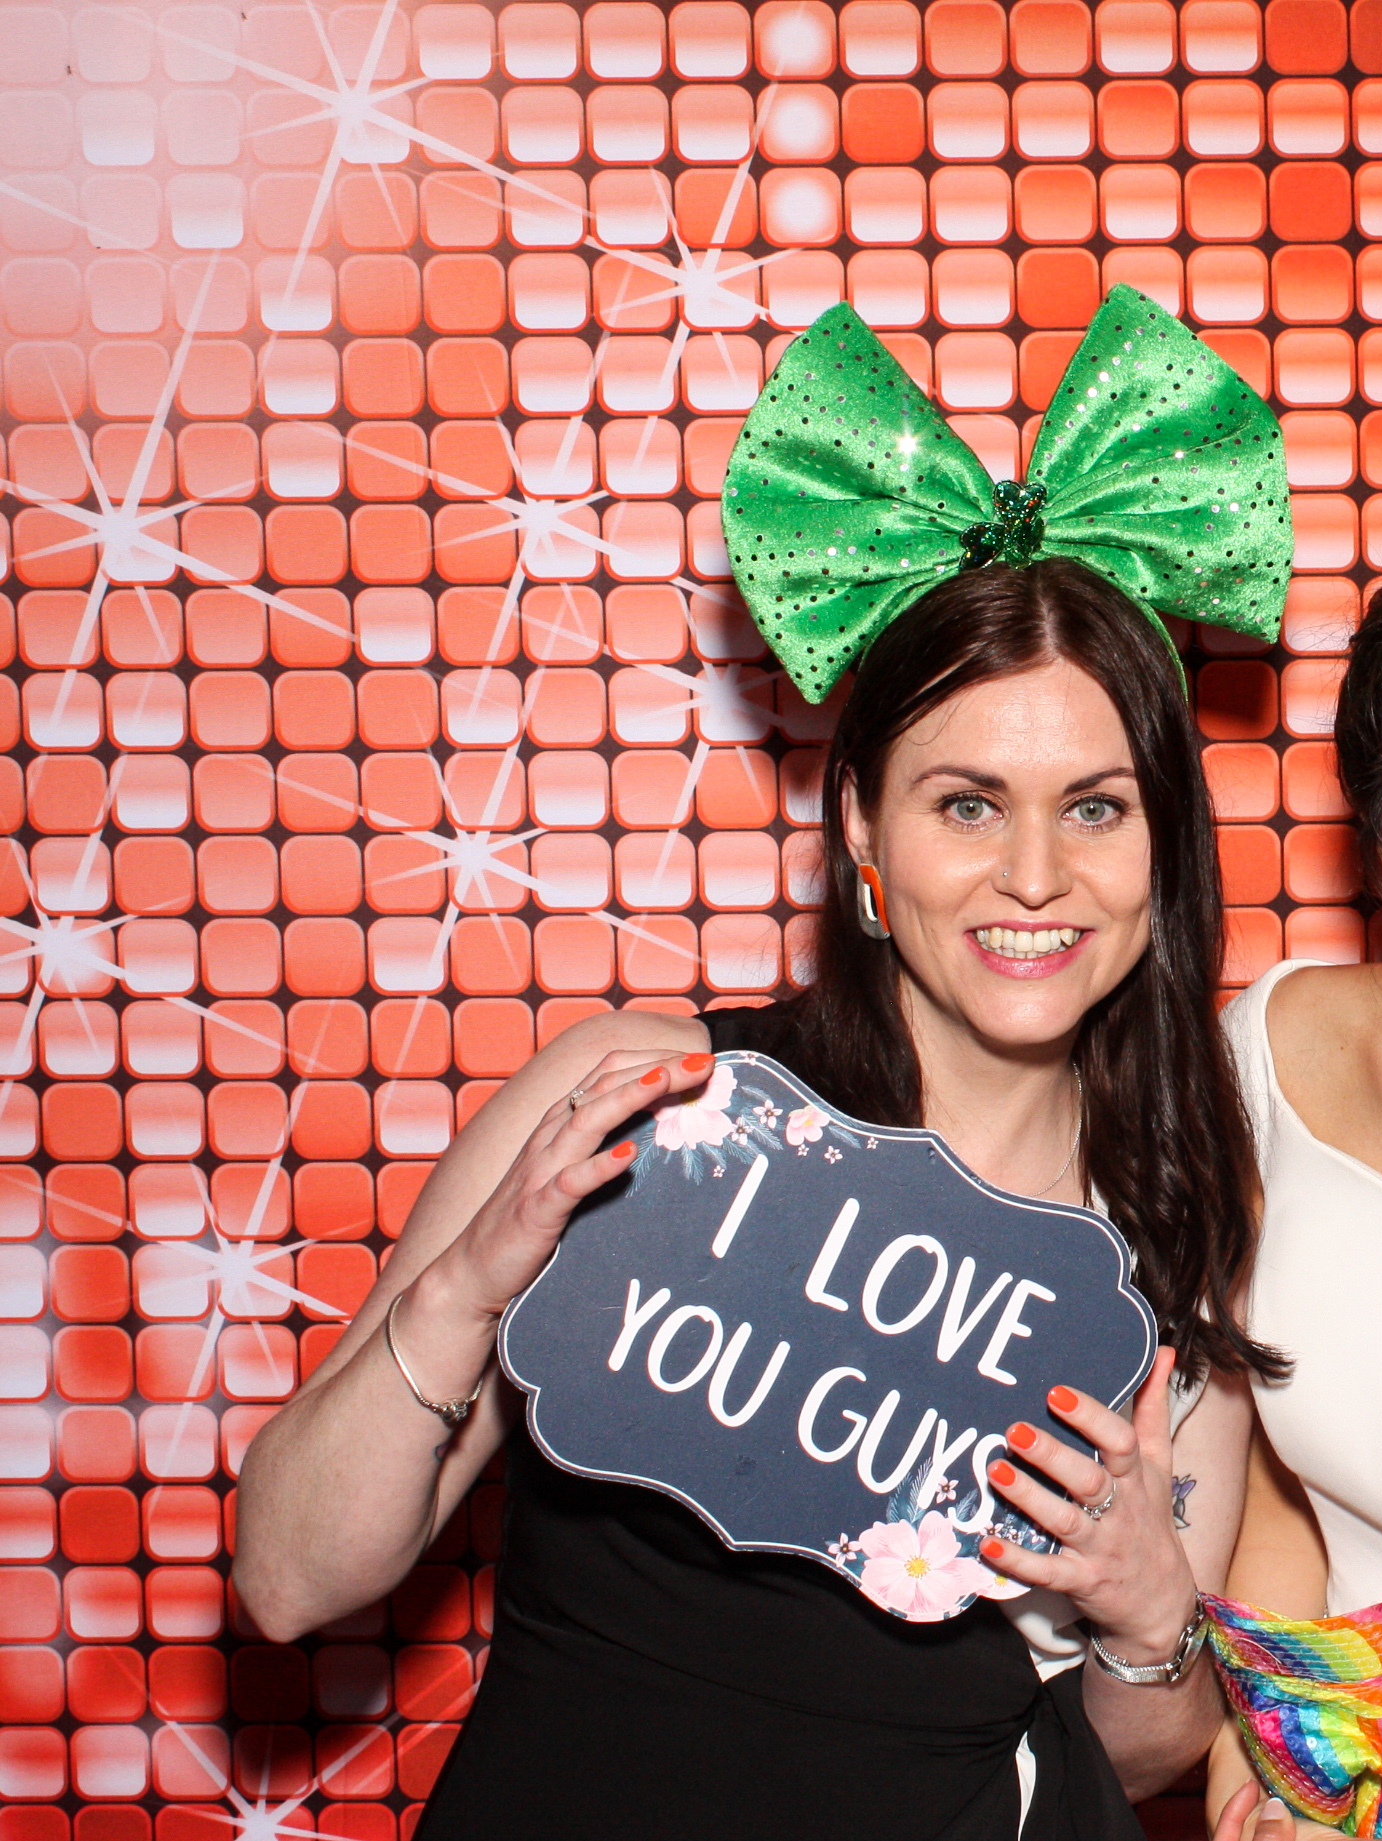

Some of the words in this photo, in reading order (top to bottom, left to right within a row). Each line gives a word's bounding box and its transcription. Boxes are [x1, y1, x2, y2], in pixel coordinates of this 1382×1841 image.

[711, 1153, 769, 1258] I
[805, 1198, 1056, 1385] LOVE
[608, 1279, 790, 1427] YOU
[798, 1366, 1009, 1533] GUYS
